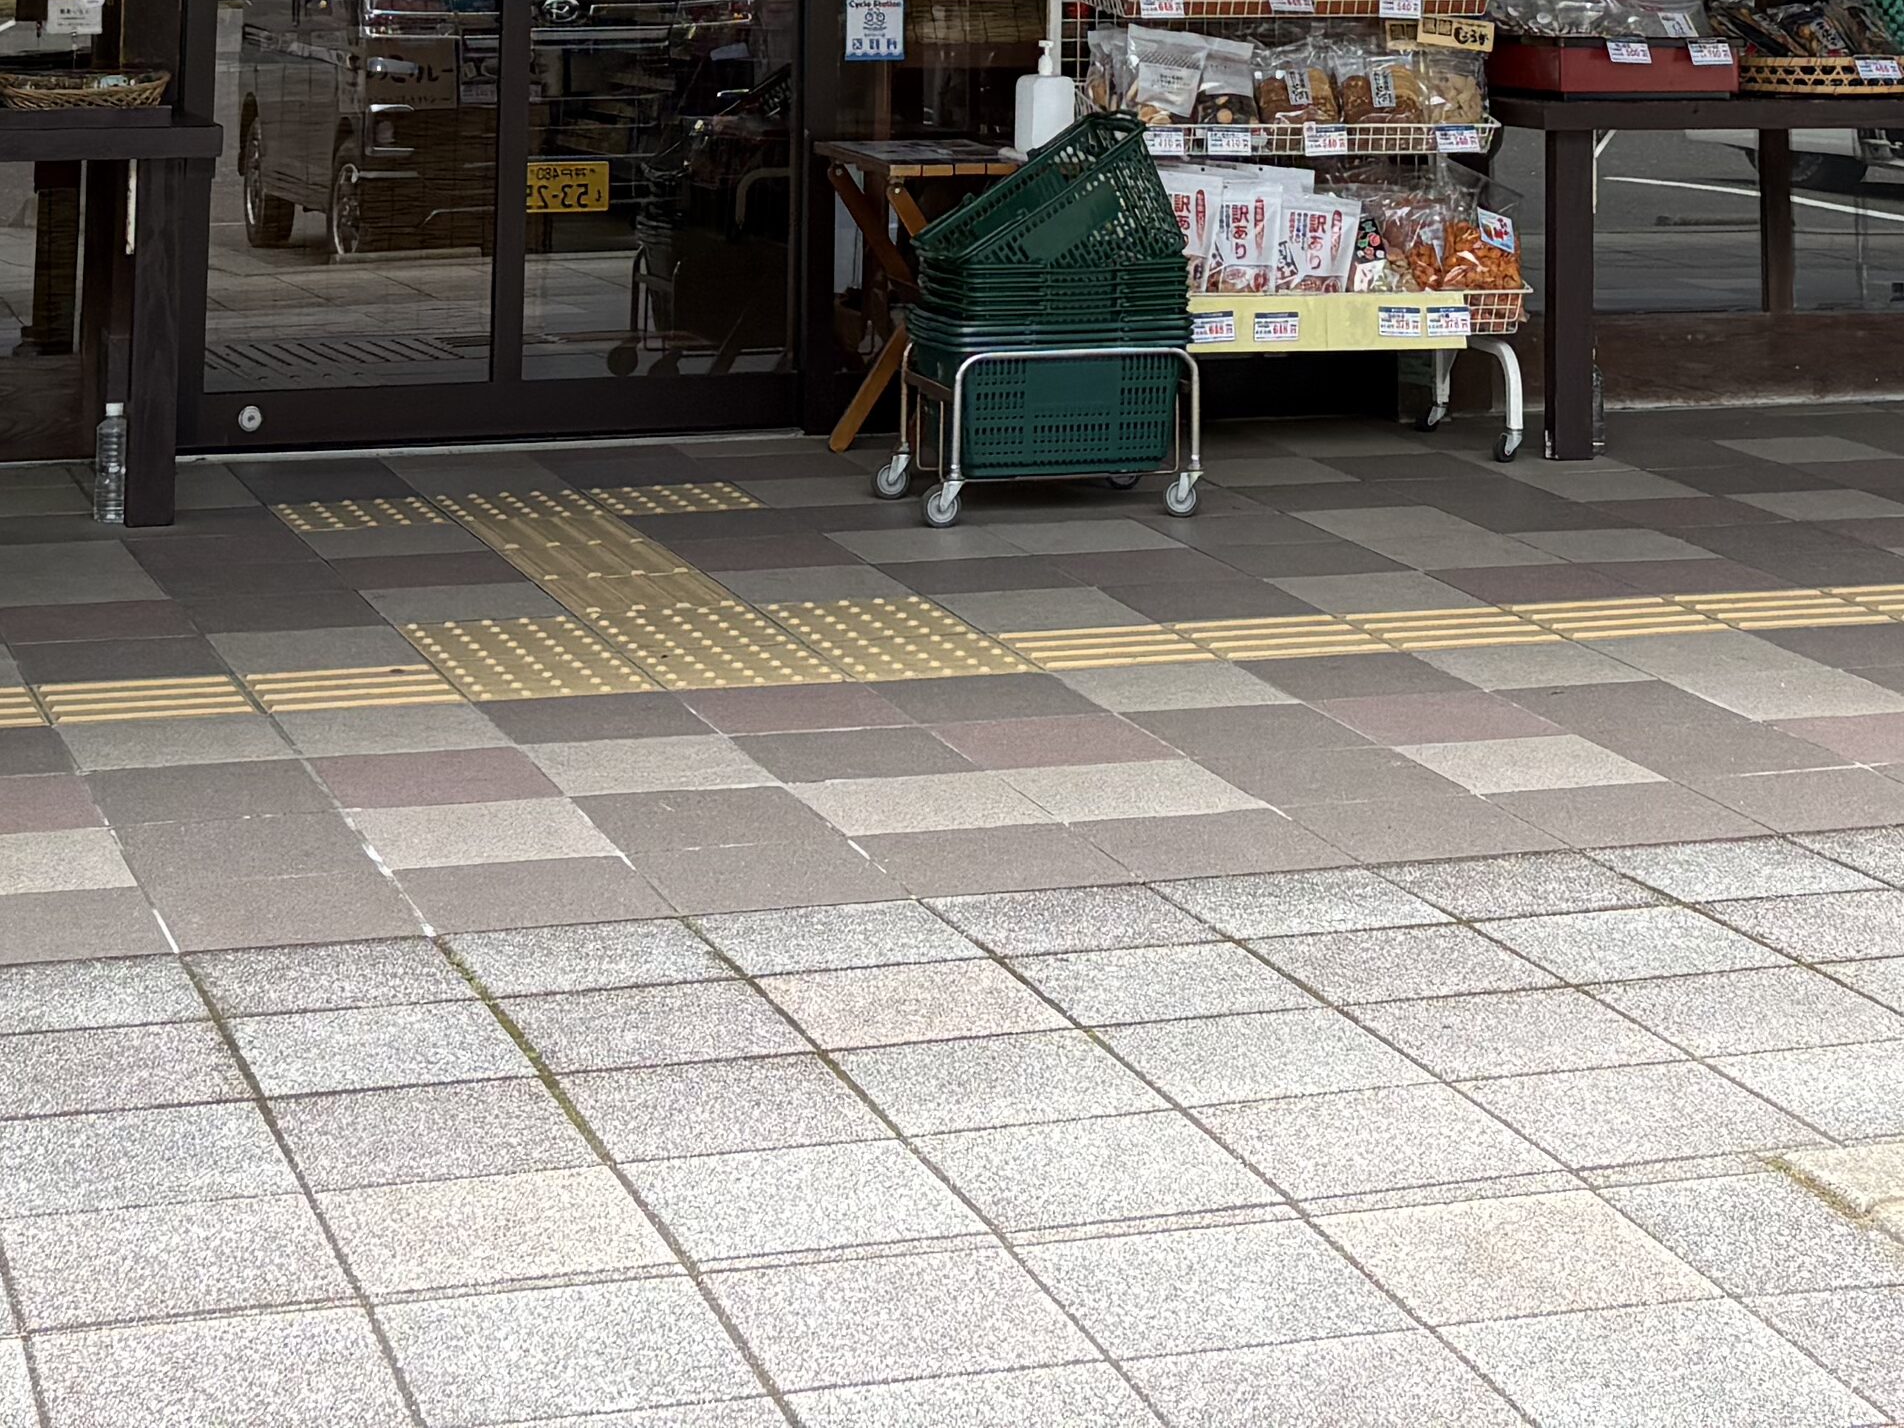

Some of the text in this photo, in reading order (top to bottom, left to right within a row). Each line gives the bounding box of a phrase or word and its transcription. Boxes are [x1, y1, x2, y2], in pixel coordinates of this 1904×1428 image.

[849, 0, 871, 8] Cycle
[1232, 205, 1250, 260] 訳あり
[1309, 214, 1327, 269] 訳あり
